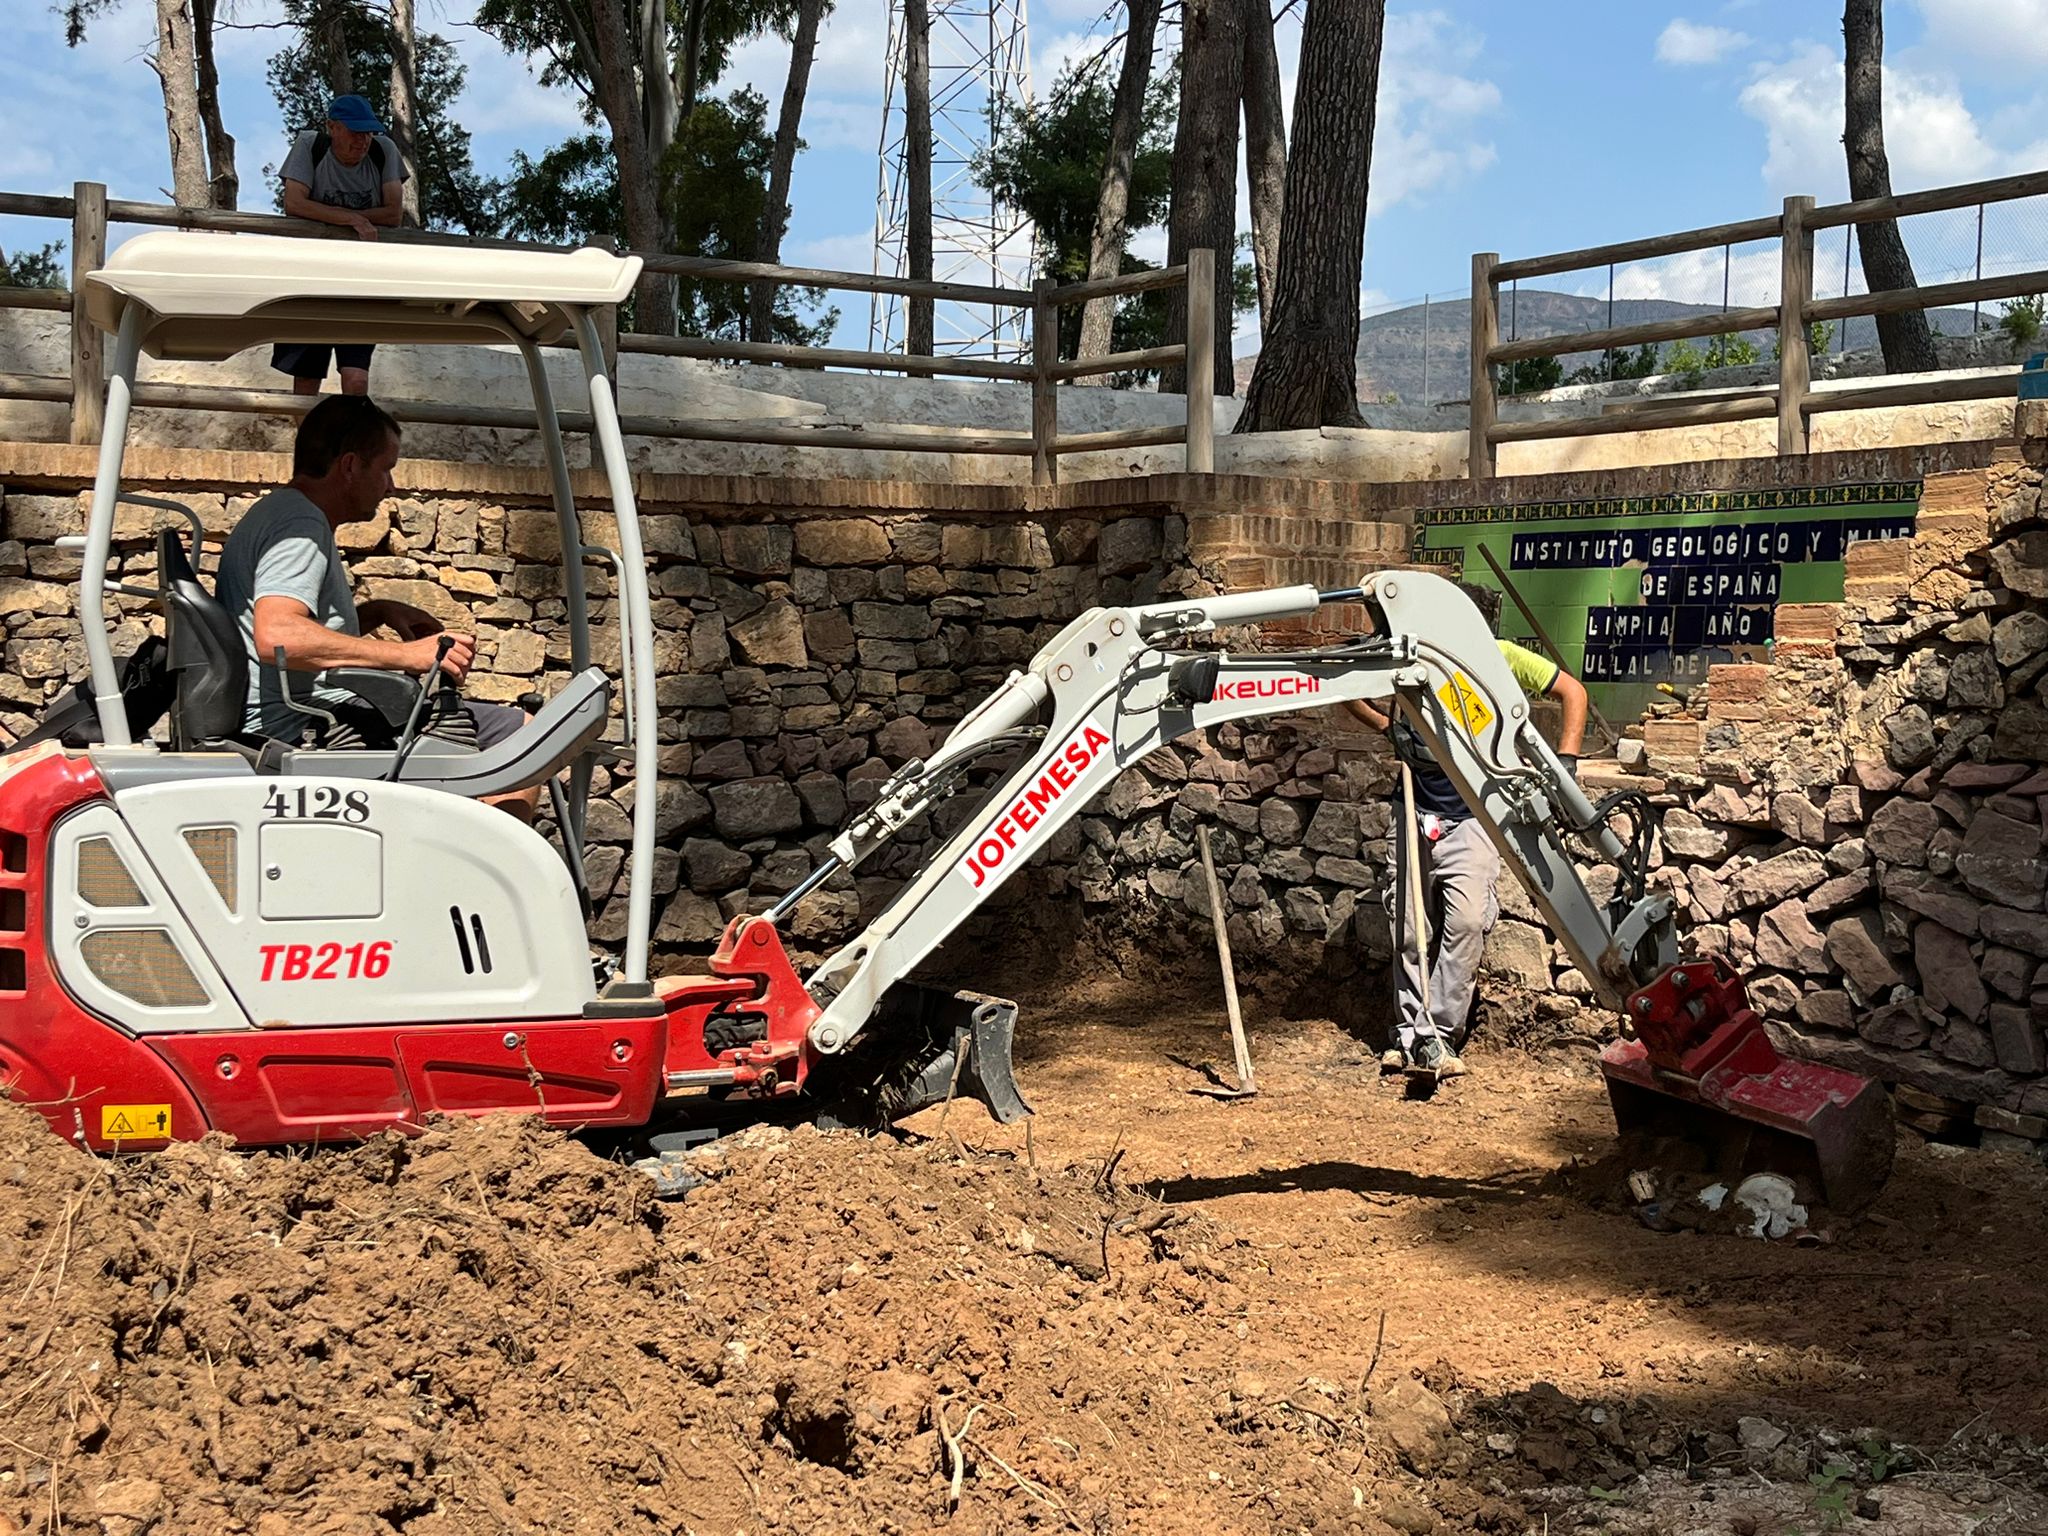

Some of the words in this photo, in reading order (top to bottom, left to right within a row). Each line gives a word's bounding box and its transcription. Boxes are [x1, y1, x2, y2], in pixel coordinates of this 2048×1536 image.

[1513, 538, 1633, 562] INSTITUTO
[1811, 531, 1821, 553] Y
[1641, 573, 1668, 597] DE
[1687, 571, 1777, 597] ESPAÑA
[1588, 615, 1670, 637] LIMPIA
[1707, 611, 1752, 636] AÑO
[1584, 654, 1653, 676] ULLAL
[262, 784, 371, 824] 4128
[964, 726, 1111, 888] JOFEMESA
[259, 941, 393, 982] TB216
